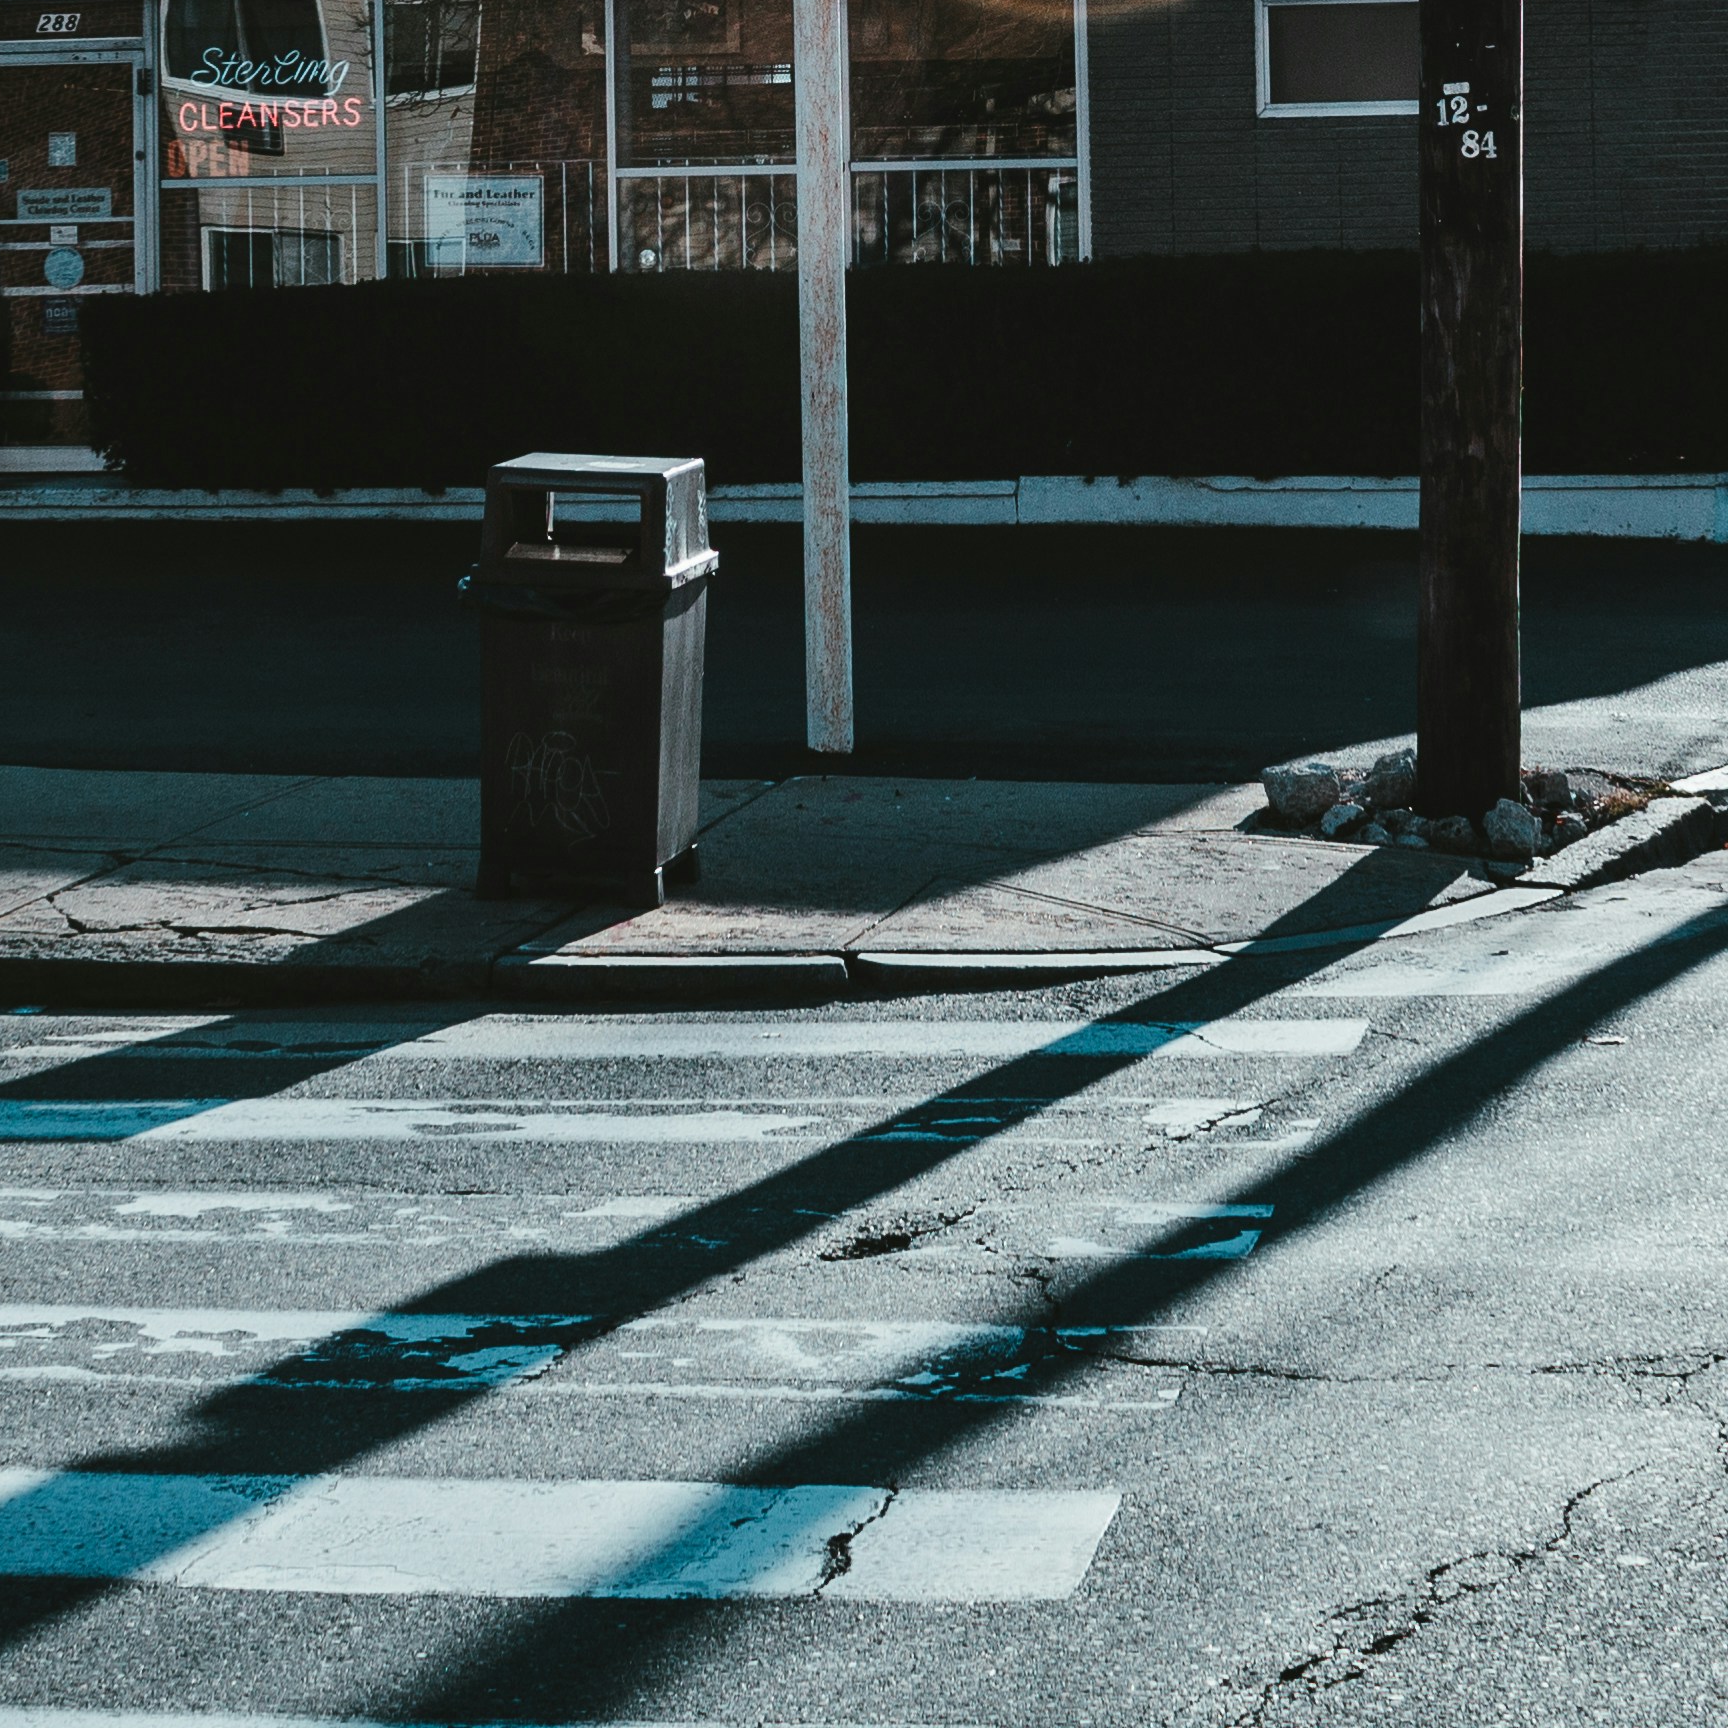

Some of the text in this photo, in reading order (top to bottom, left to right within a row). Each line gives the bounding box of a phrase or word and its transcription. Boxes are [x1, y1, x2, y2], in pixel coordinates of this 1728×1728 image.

[38, 15, 78, 32] 288
[190, 47, 350, 96] Sterling
[179, 97, 362, 132] CLEANSERS
[167, 139, 250, 178] OPEN
[1461, 130, 1497, 159] 84
[459, 188, 483, 199] and
[486, 188, 535, 199] Leather
